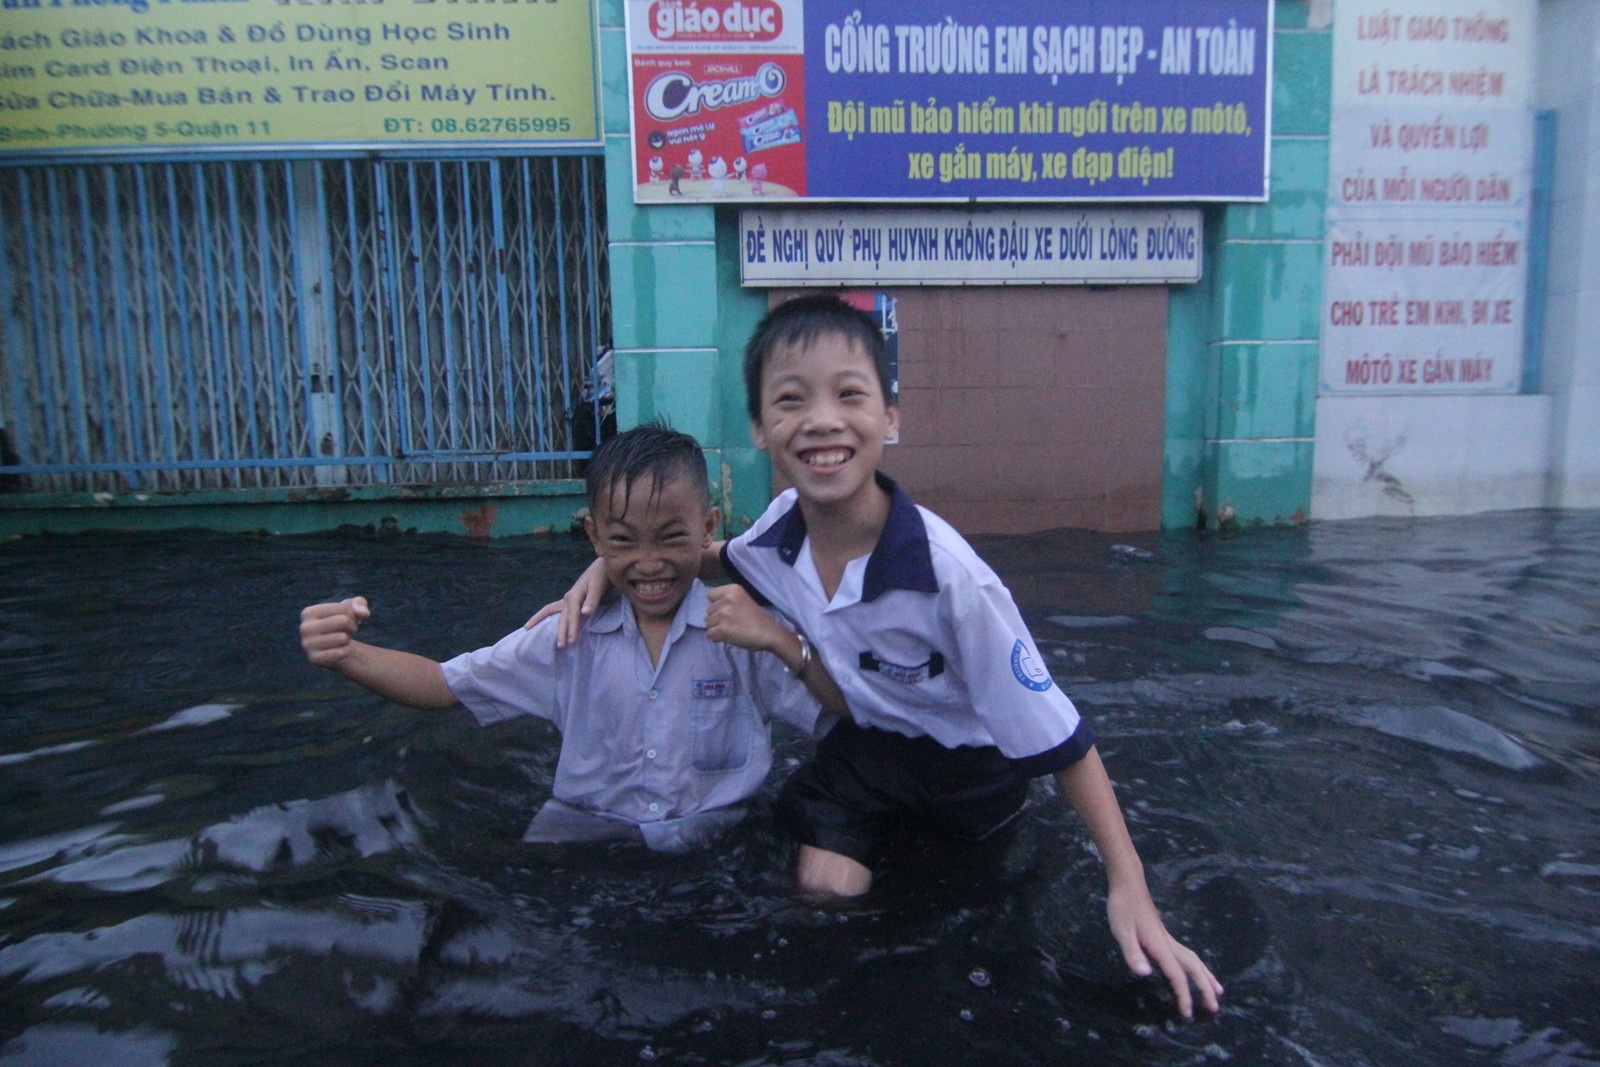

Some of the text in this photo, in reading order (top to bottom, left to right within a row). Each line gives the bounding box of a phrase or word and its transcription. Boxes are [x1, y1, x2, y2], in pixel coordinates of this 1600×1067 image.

[0, 20, 510, 50] ách Giáo Khoa & Đồ Dùng Học Sinh
[657, 1, 775, 39] giáo dục
[1358, 8, 1509, 44] LUẬT GIAO THÔNG
[825, 9, 890, 73] CỔNG
[895, 16, 989, 74] TRƯỜNG
[995, 26, 1027, 74] EM
[1033, 25, 1095, 85] SẠCH
[1100, 26, 1144, 85] ĐẸP
[1160, 27, 1192, 74] AN
[1196, 18, 1255, 75] TOÀN
[0, 61, 36, 78] im
[44, 60, 110, 78] Card
[119, 58, 184, 76] Điện
[289, 55, 314, 72] In
[380, 54, 449, 70] Scan
[1358, 64, 1380, 94] LÀ
[1387, 64, 1443, 95] TRÁCH
[198, 87, 252, 104] Bán
[264, 86, 281, 103] &
[292, 85, 355, 102] Trao
[364, 80, 411, 102] Đổi
[421, 84, 476, 104] Máy
[486, 84, 556, 101] Tính.
[248, 119, 271, 134] 11
[384, 118, 423, 133] ĐT:
[431, 117, 571, 133] 08.62765995
[828, 96, 1252, 141] Đội mũ bảo hiểm khi ngồi trên xe môtô,
[908, 143, 1174, 185] xe gắn máy, xe đạp điện!
[747, 213, 1195, 271] ĐỀ NGHỊ QUÝ PHỤ HUYNH KHÔNG ĐẬU XE DƯỚI LÒNG ĐƯỜNG
[1331, 231, 1369, 267] PHẢI
[1330, 300, 1363, 326] CHO
[1369, 292, 1400, 325] TRẺ
[1405, 301, 1430, 325] EM
[1491, 300, 1513, 324] XE
[1397, 360, 1418, 384] XE
